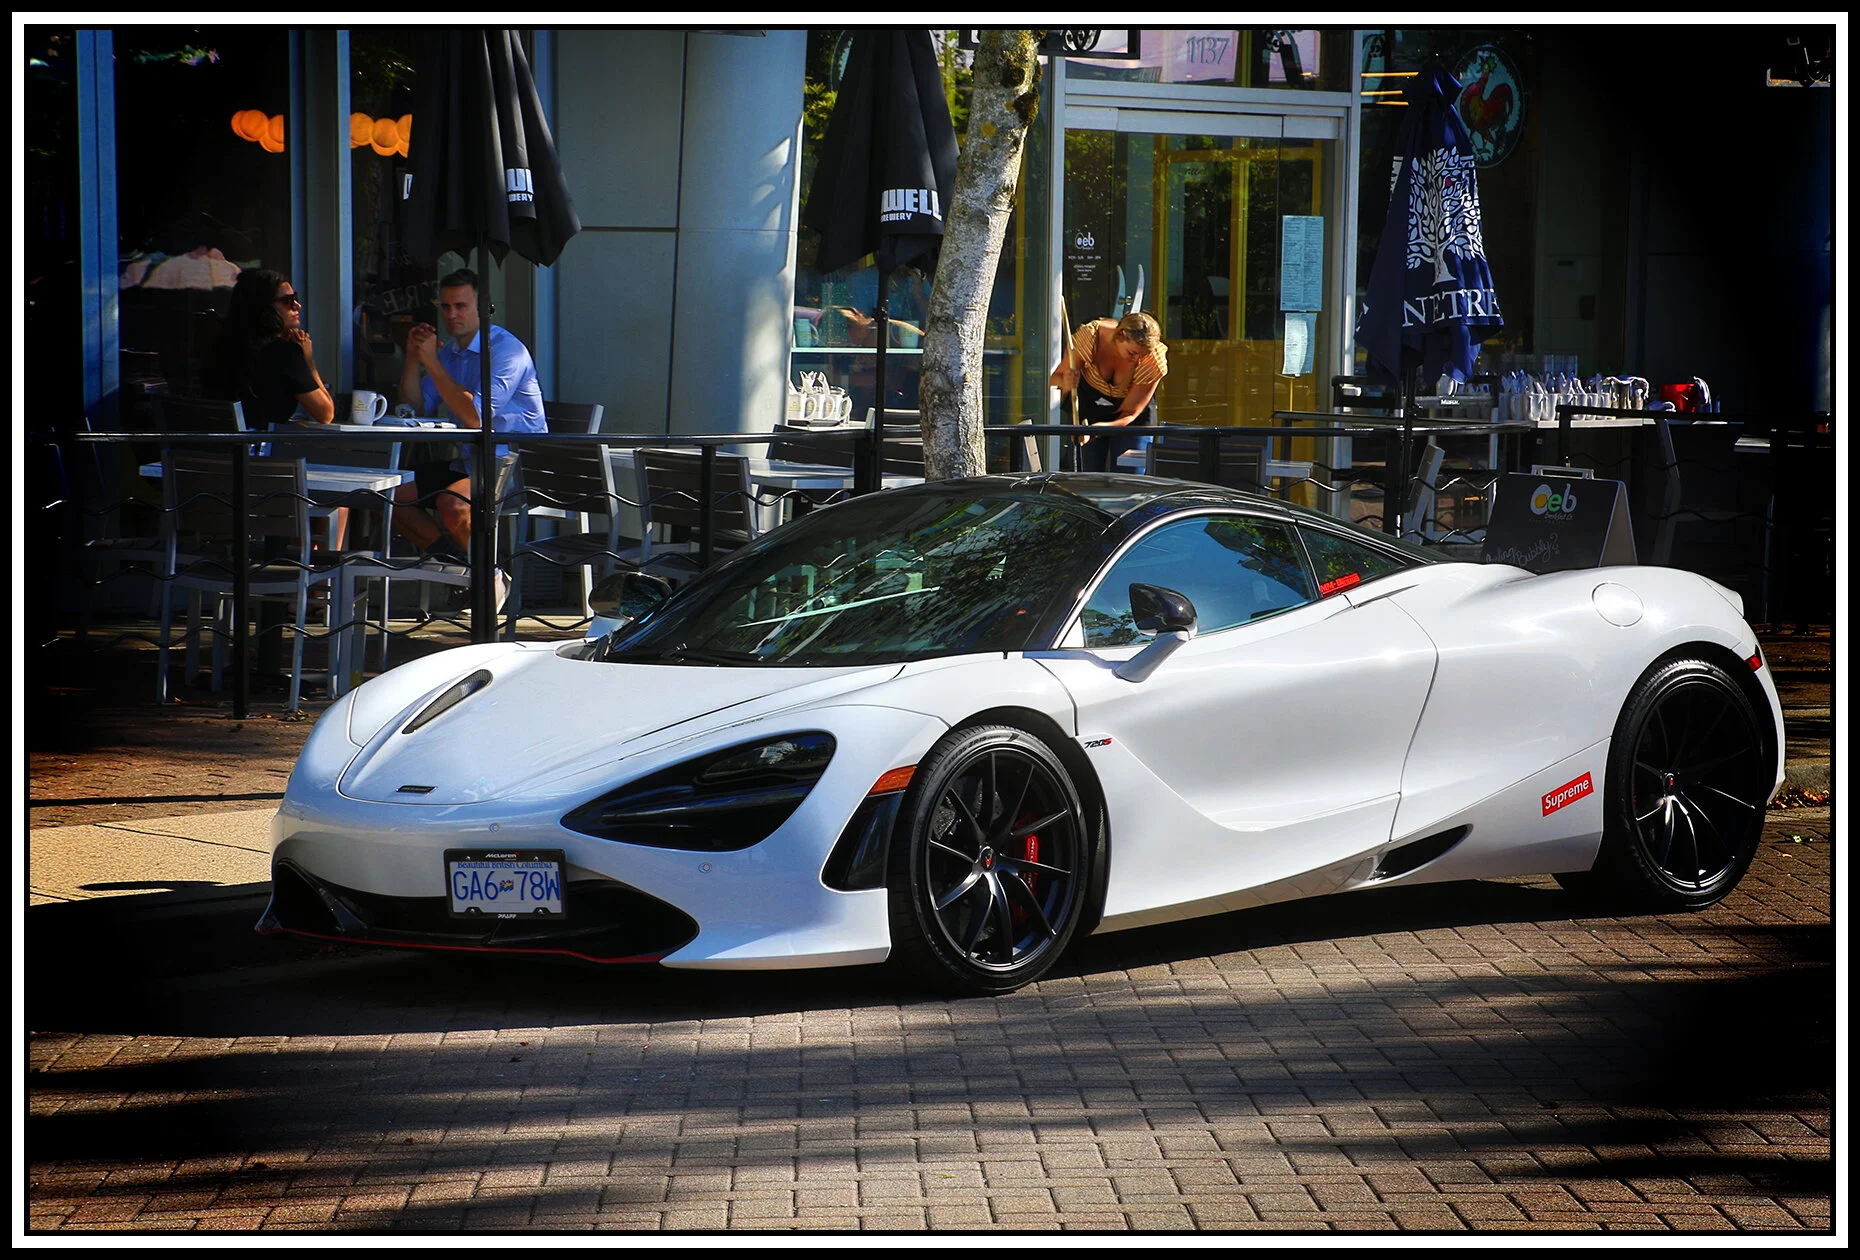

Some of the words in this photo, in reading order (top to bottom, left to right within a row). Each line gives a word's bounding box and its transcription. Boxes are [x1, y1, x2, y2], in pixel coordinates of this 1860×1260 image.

[1187, 36, 1230, 64] 1137
[881, 189, 942, 221] WELL
[1402, 288, 1500, 327] NETRE
[1084, 738, 1112, 749] 720S
[1545, 779, 1589, 810] Supreme
[453, 871, 498, 900] GA6
[514, 871, 560, 901] 78W
